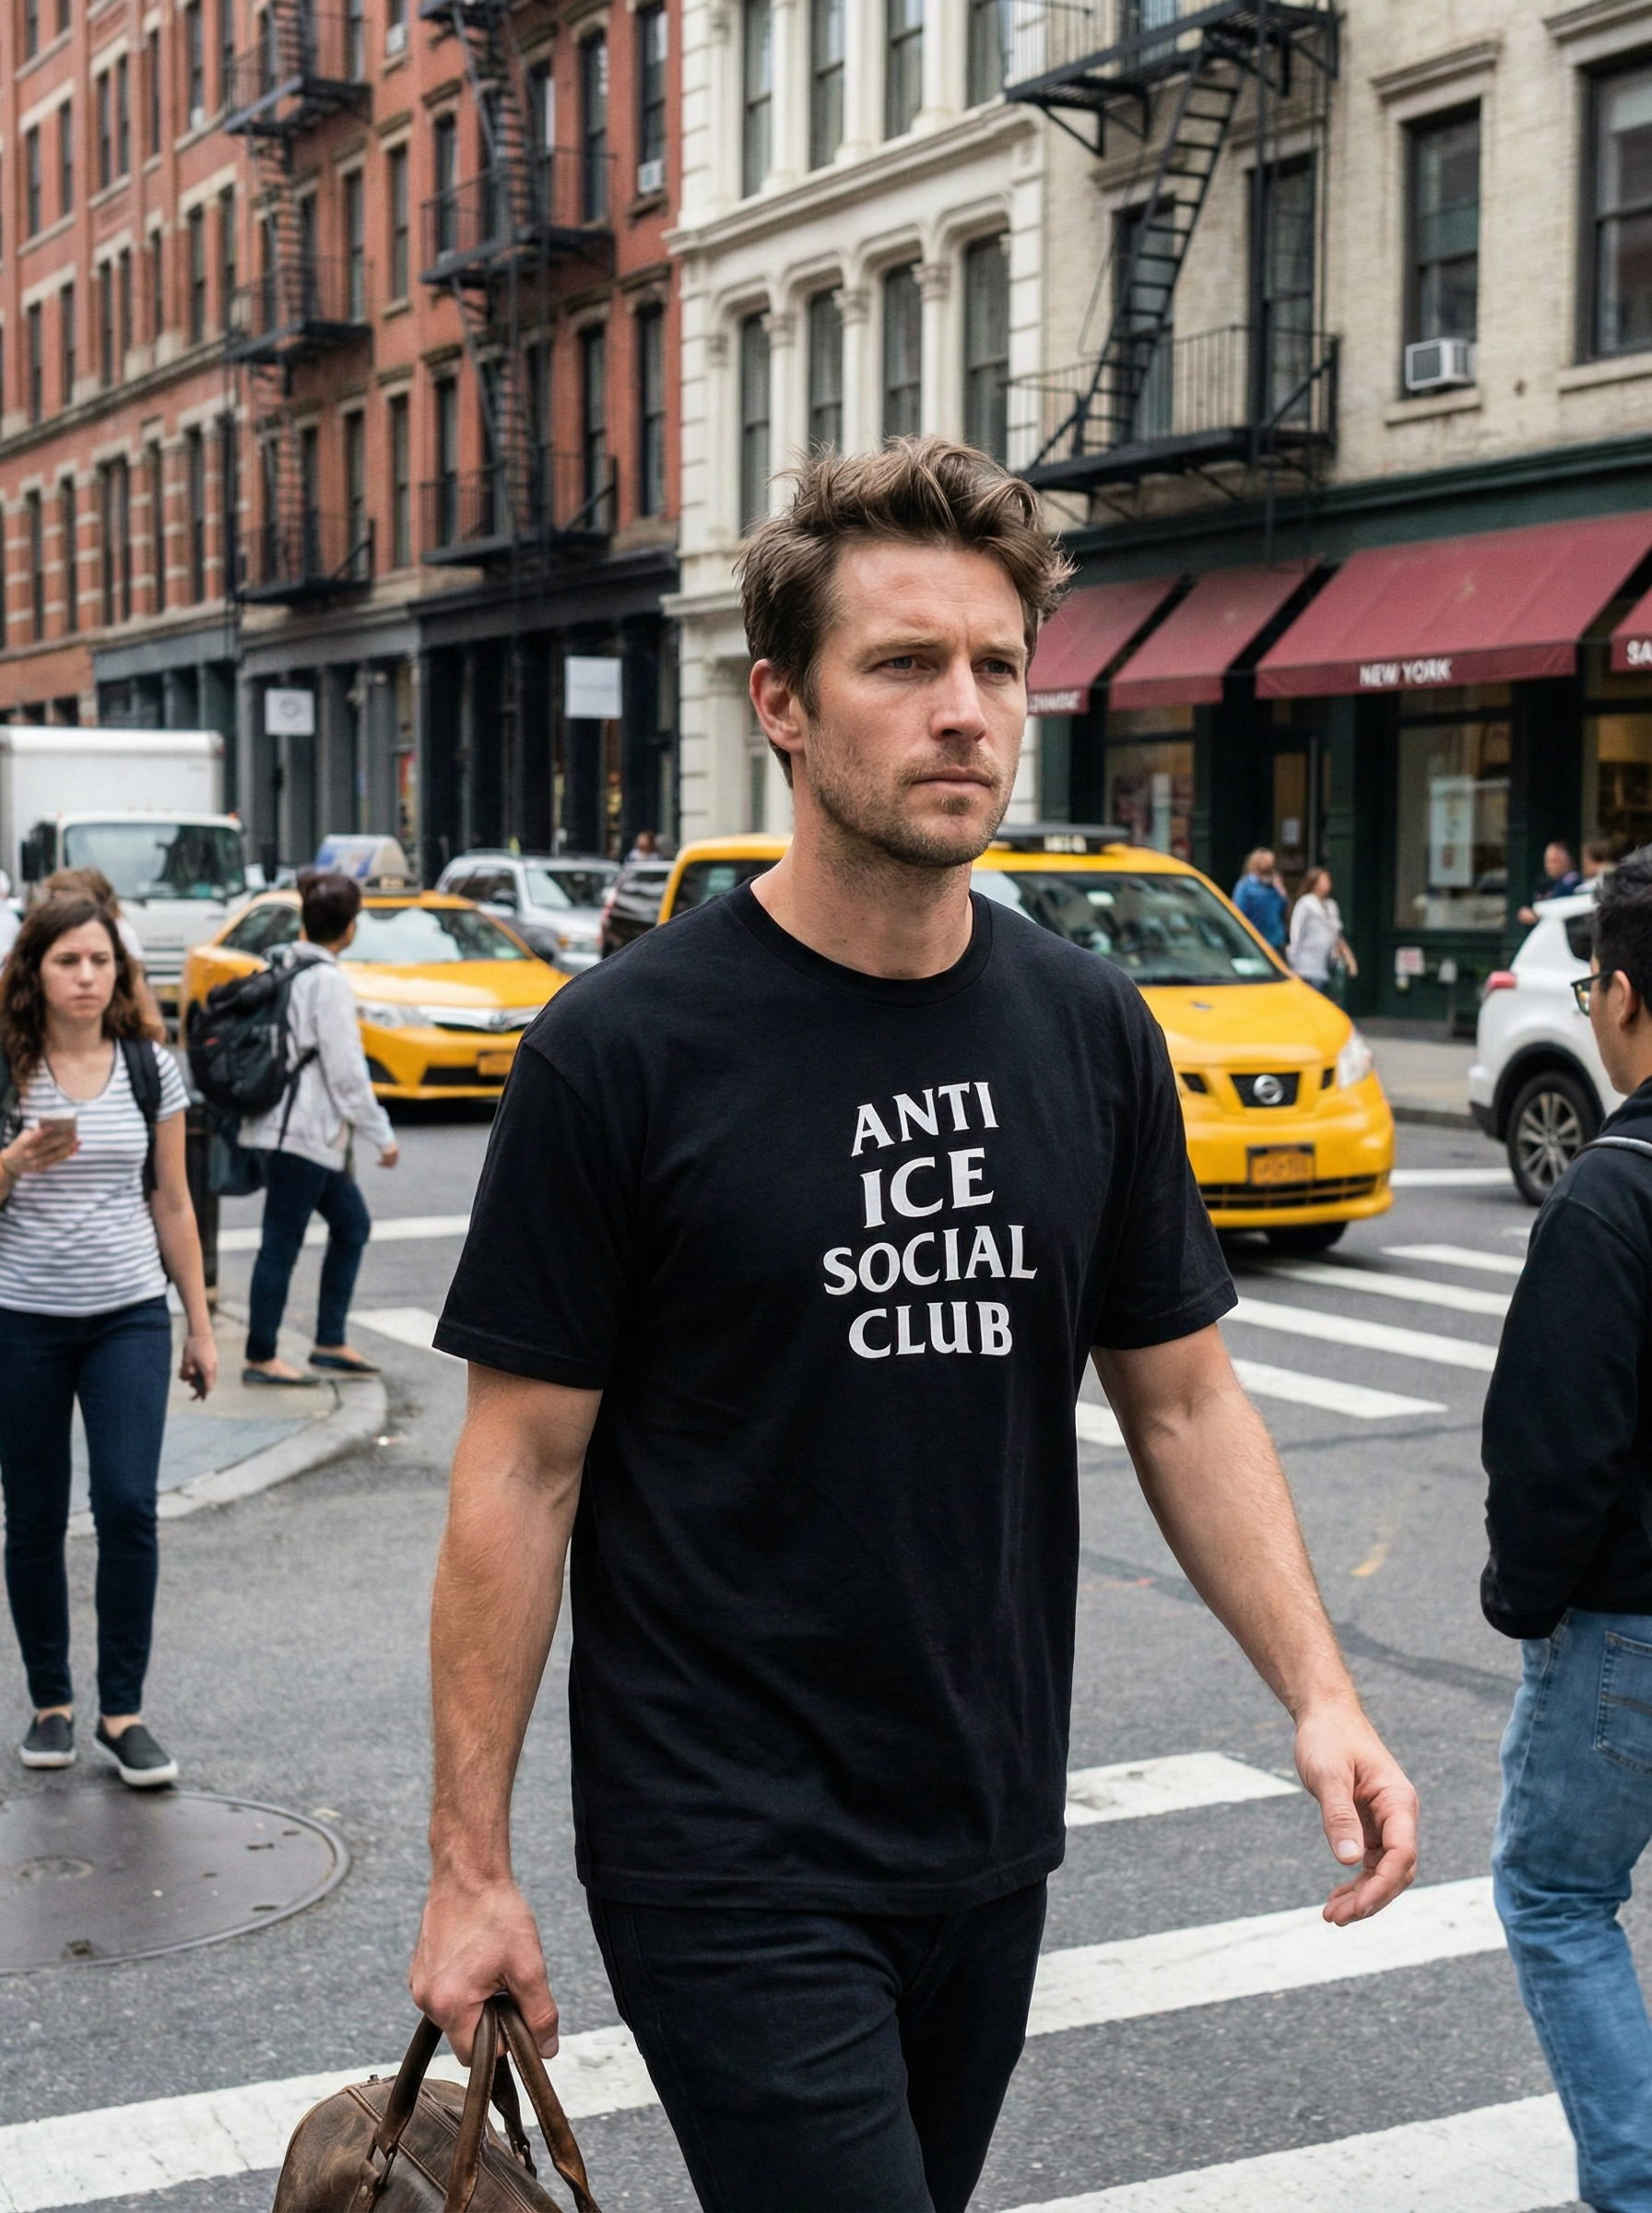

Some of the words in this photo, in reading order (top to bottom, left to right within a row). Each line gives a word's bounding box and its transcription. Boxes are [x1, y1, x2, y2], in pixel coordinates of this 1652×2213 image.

[1360, 662, 1400, 687] NEW
[1401, 657, 1453, 685] YORK
[851, 1082, 999, 1157] ANTI
[860, 1147, 995, 1229] ICE
[823, 1225, 1038, 1296] SOCIAL
[848, 1301, 1013, 1359] CLUB
